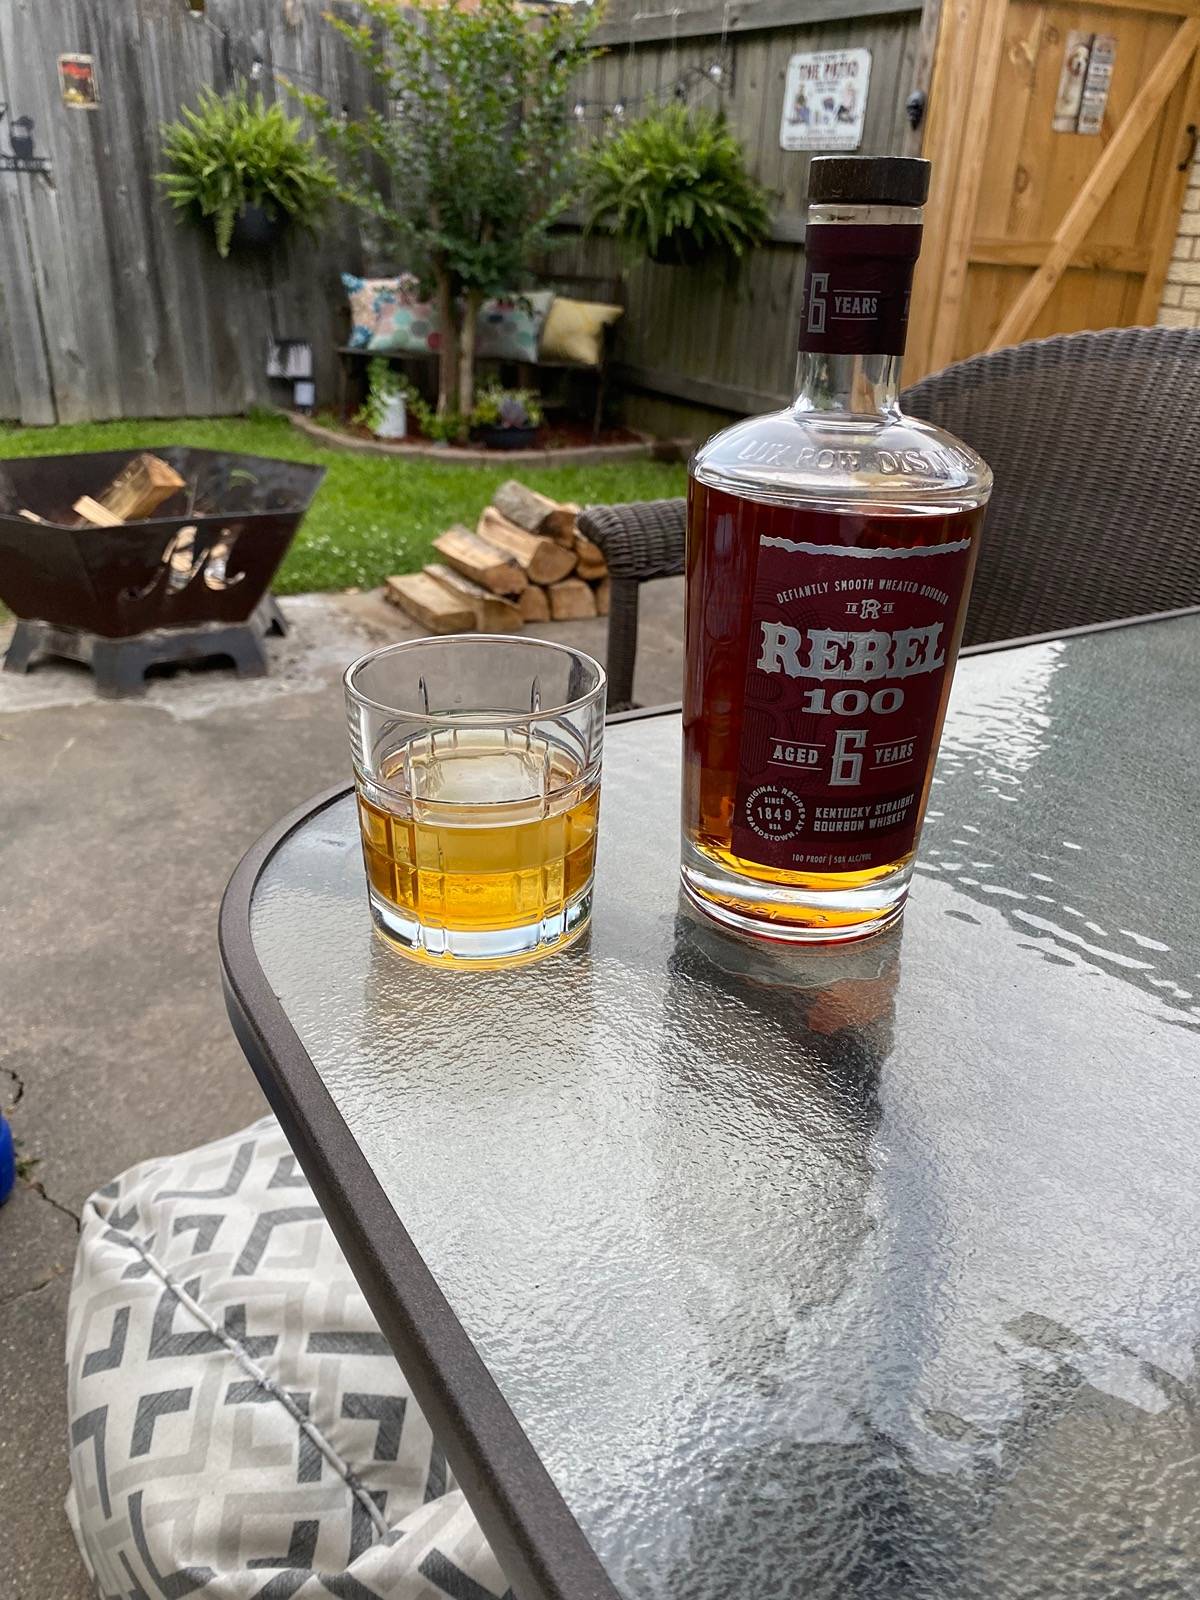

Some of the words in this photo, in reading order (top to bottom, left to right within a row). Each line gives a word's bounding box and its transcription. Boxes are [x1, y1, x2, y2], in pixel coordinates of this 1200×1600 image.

[807, 272, 830, 333] 6
[834, 296, 878, 314] YEARS
[776, 582, 829, 604] DEFIANTLY
[834, 579, 874, 592] SMOOTH
[879, 579, 919, 594] WHEATED
[757, 621, 945, 684] REBEL
[801, 687, 905, 717] 100
[772, 744, 819, 765] AGED
[828, 729, 870, 787] 6
[875, 742, 914, 764] YEARS
[745, 785, 777, 808] ORIGINAL
[781, 787, 806, 814] RECIPE
[764, 796, 785, 805] SINCE
[815, 806, 871, 819] KENTUCKY
[874, 793, 915, 816] STRAIGHT
[757, 806, 792, 822] 1849
[813, 820, 865, 832] BOURBON
[868, 809, 907, 830] WHISKEY
[792, 853, 804, 862] 100
[806, 855, 826, 864] PROOF
